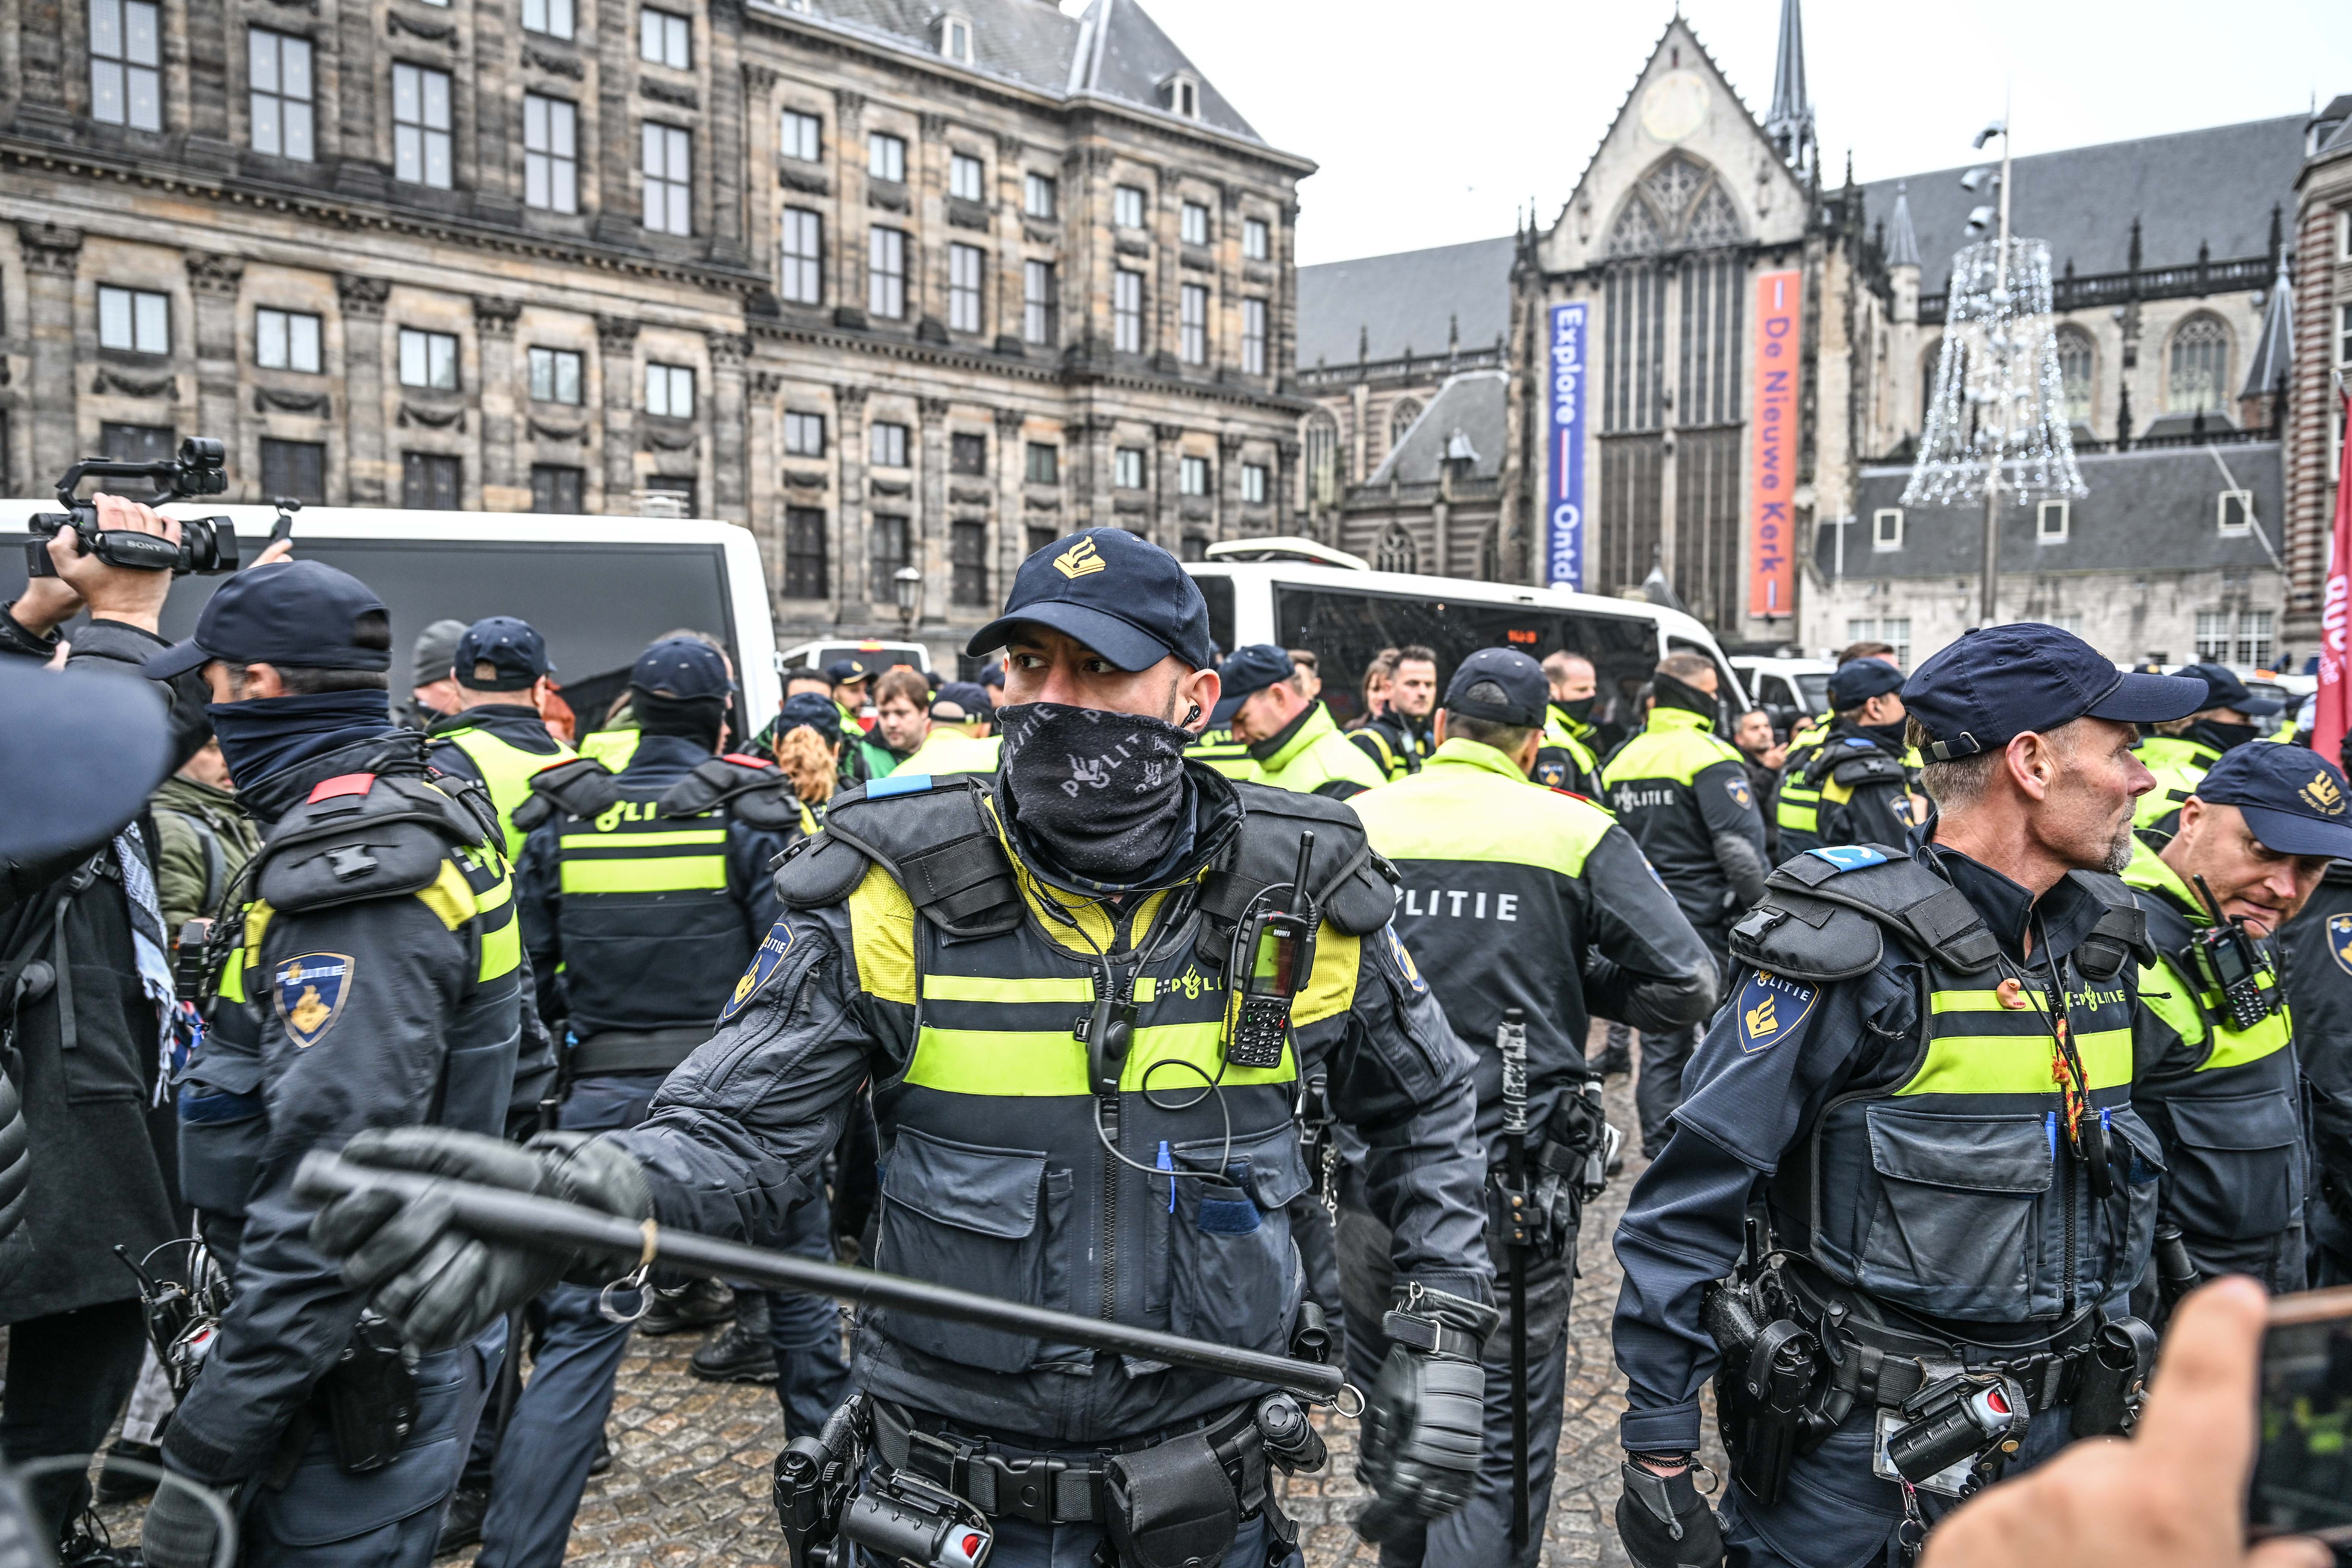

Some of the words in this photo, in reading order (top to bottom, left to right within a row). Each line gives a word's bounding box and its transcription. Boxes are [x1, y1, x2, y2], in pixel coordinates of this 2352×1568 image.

[1765, 318, 1789, 357] De
[1552, 308, 1582, 425] Explore
[1761, 371, 1789, 489] Nieuwe
[126, 540, 161, 552] SONY
[1759, 502, 1785, 572] Kerk
[1273, 929, 1290, 937] sepura
[1752, 969, 1810, 1001] POLITIE
